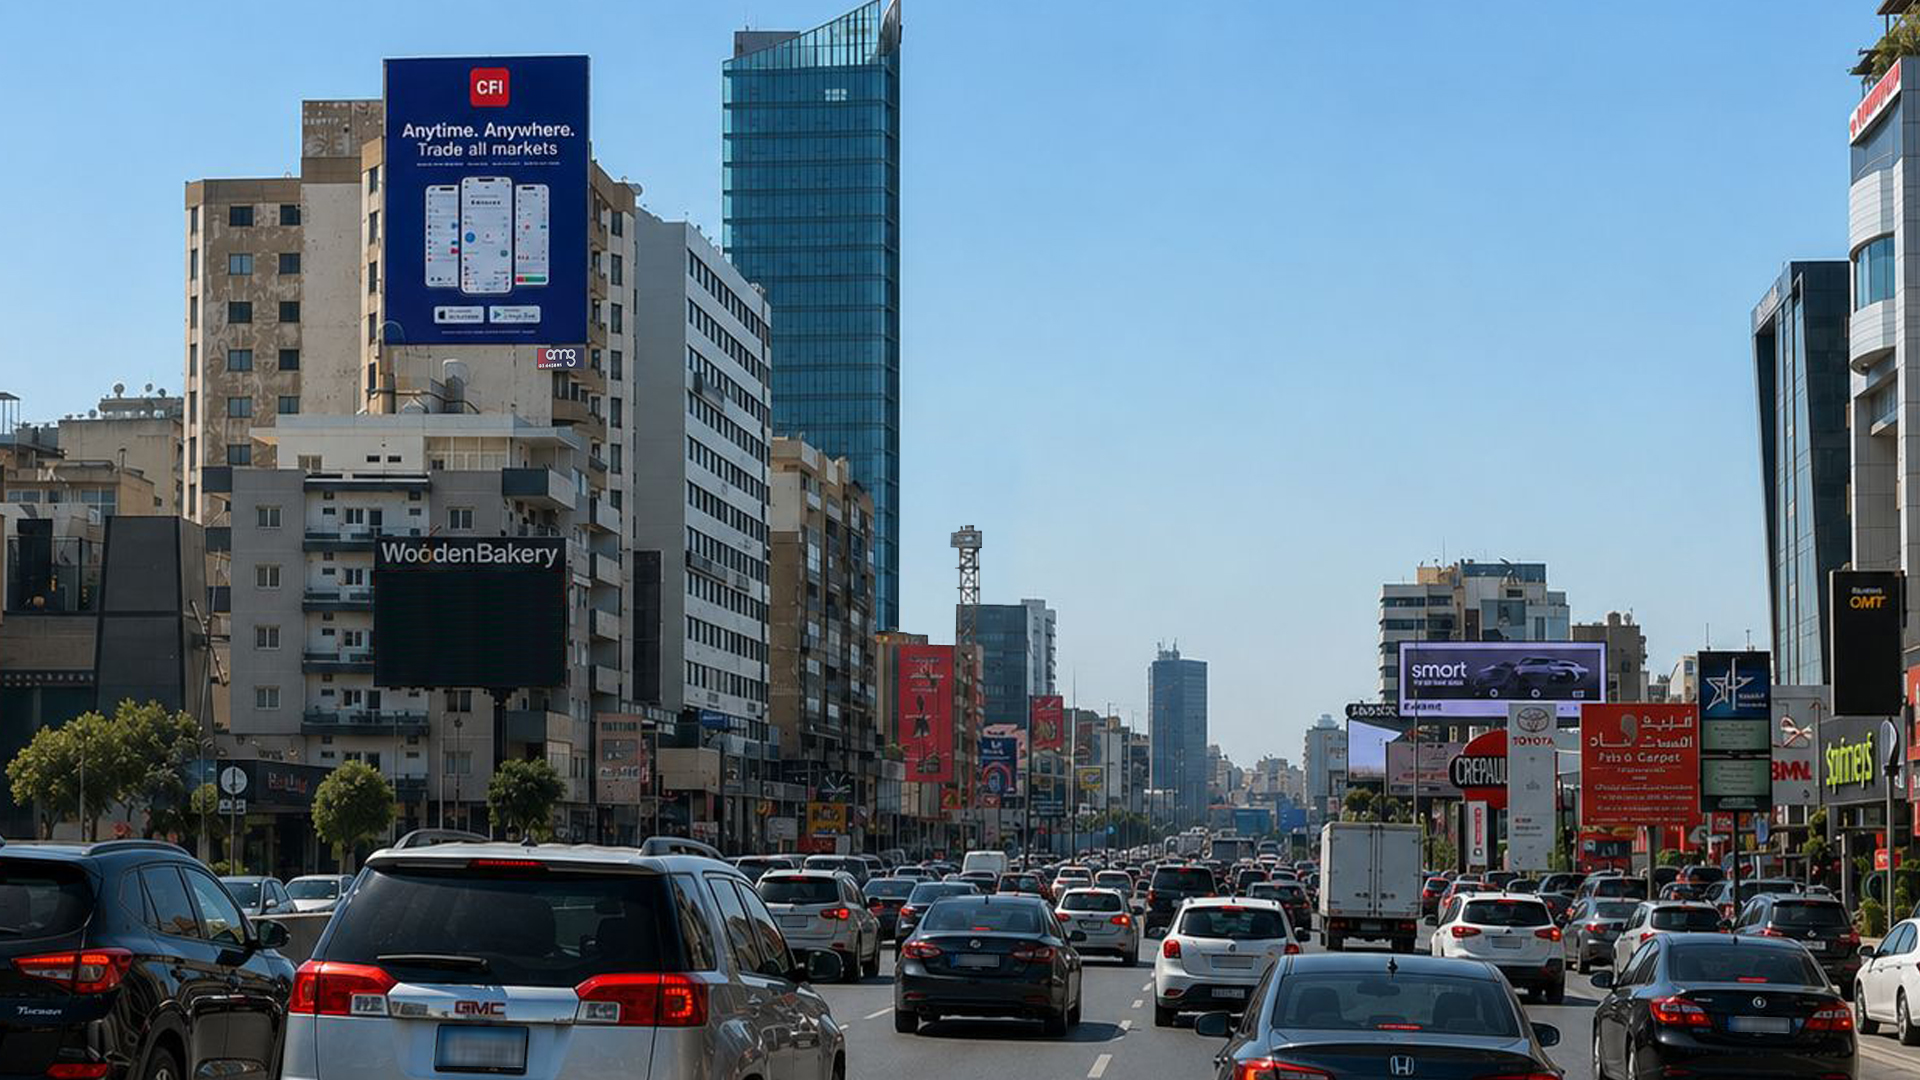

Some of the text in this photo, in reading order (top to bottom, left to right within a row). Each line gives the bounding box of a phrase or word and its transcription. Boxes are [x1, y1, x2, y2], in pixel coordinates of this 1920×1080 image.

[476, 80, 503, 94] CFI
[402, 122, 575, 141] Anytime. Anywhere.
[417, 142, 558, 156] Trade all markets
[1850, 596, 1882, 609] OMT
[1513, 736, 1554, 747] TOYOTA
[454, 1001, 505, 1015] GMC
